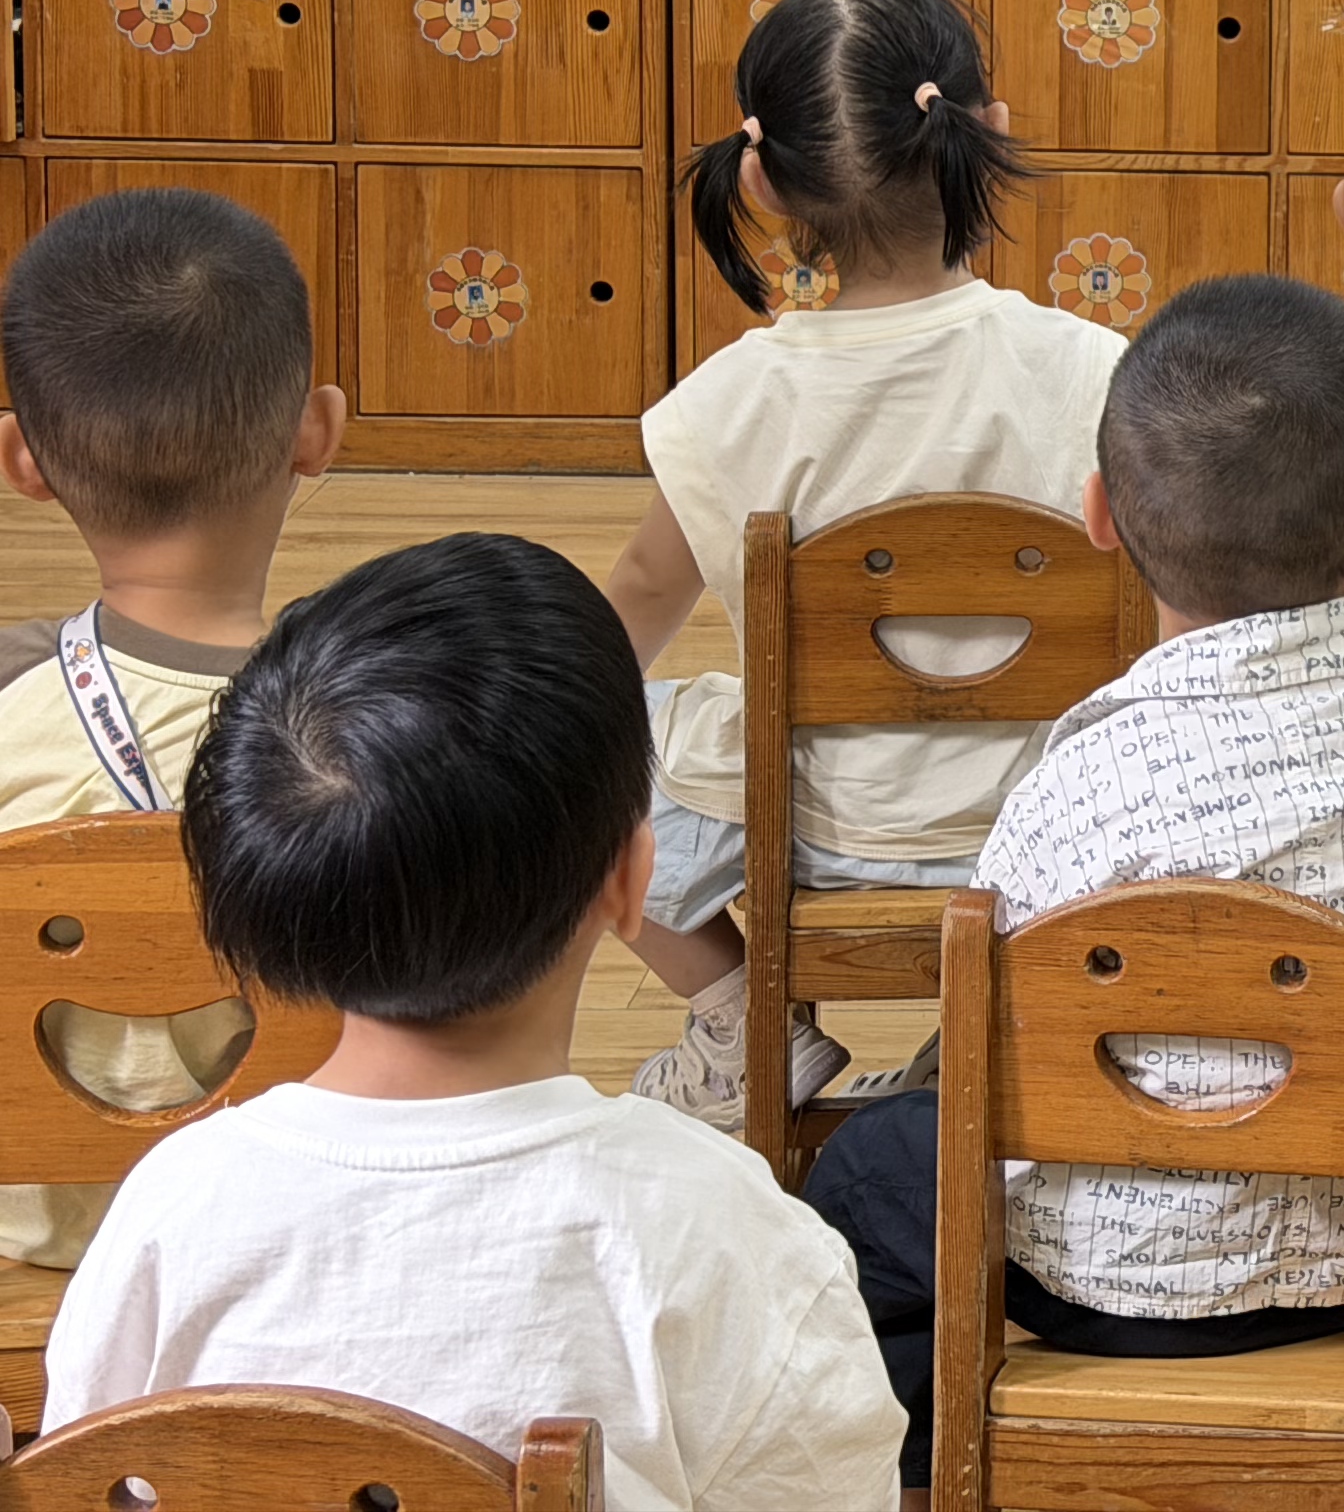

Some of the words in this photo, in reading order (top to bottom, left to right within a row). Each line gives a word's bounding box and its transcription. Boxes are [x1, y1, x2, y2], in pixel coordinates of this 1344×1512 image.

[1231, 609, 1301, 636] STATE
[91, 693, 125, 745] Space
[1238, 1051, 1286, 1070] THE
[1164, 1081, 1216, 1097] THE
[1096, 1215, 1140, 1236] THE
[1027, 1227, 1074, 1253] THE
[1046, 1262, 1188, 1297] EMOTIONAL
